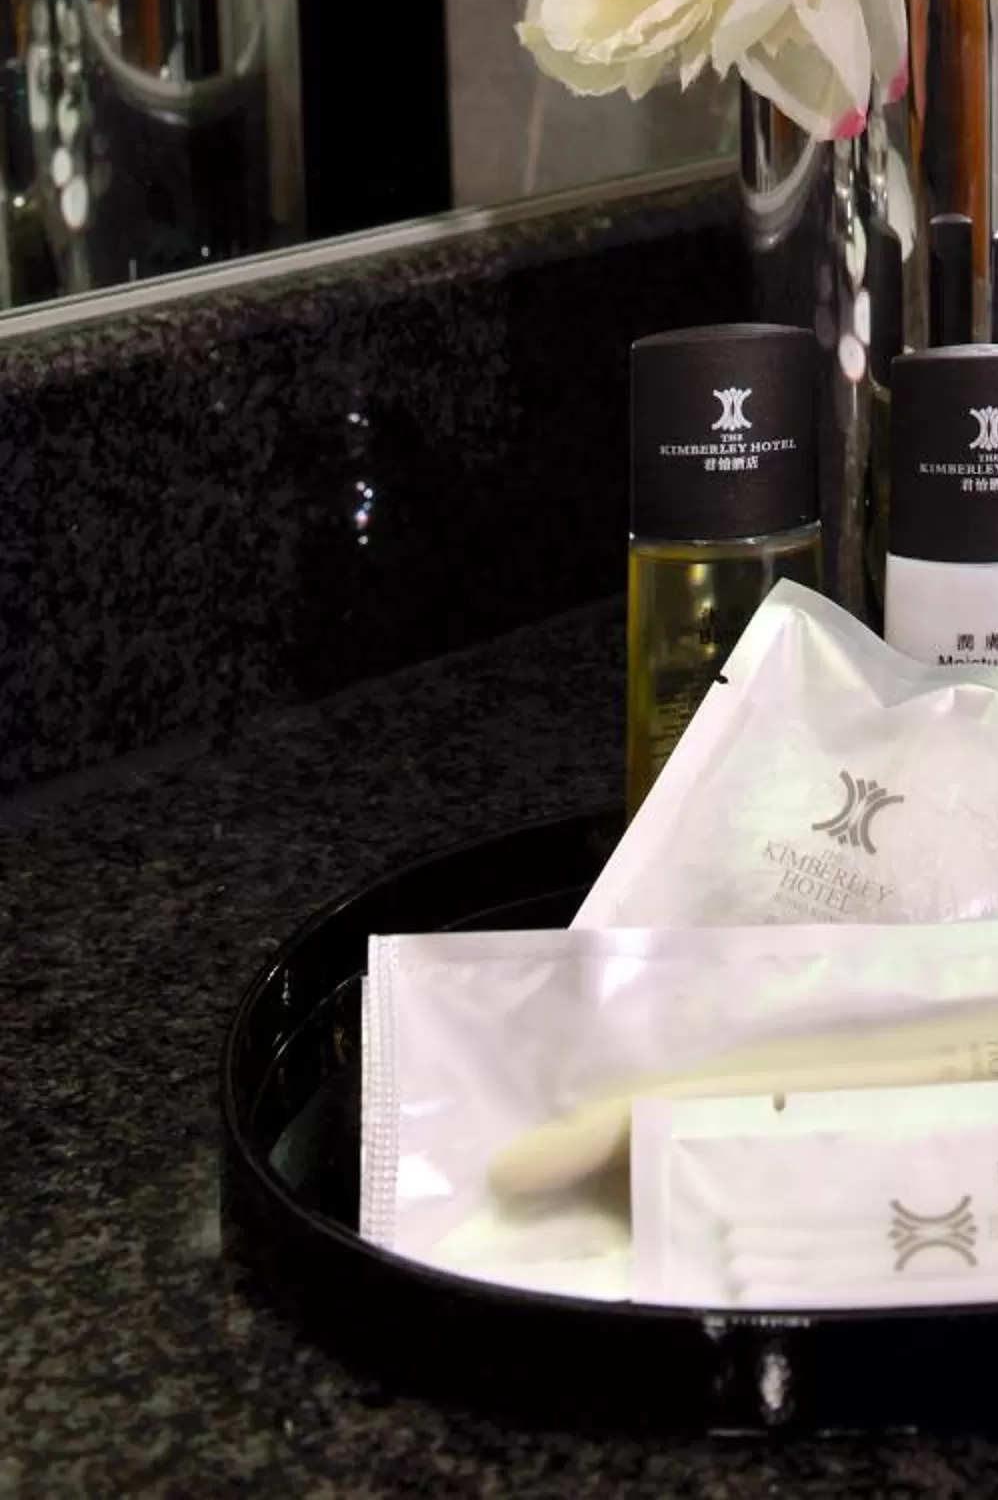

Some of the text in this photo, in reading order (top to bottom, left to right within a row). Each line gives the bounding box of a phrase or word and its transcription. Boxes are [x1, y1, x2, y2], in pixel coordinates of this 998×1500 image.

[660, 439, 797, 456] KIMBERLEY HOTEL
[721, 433, 743, 442] THE
[761, 839, 896, 905] KIMBERLEY
[778, 868, 852, 914] HOTEL
